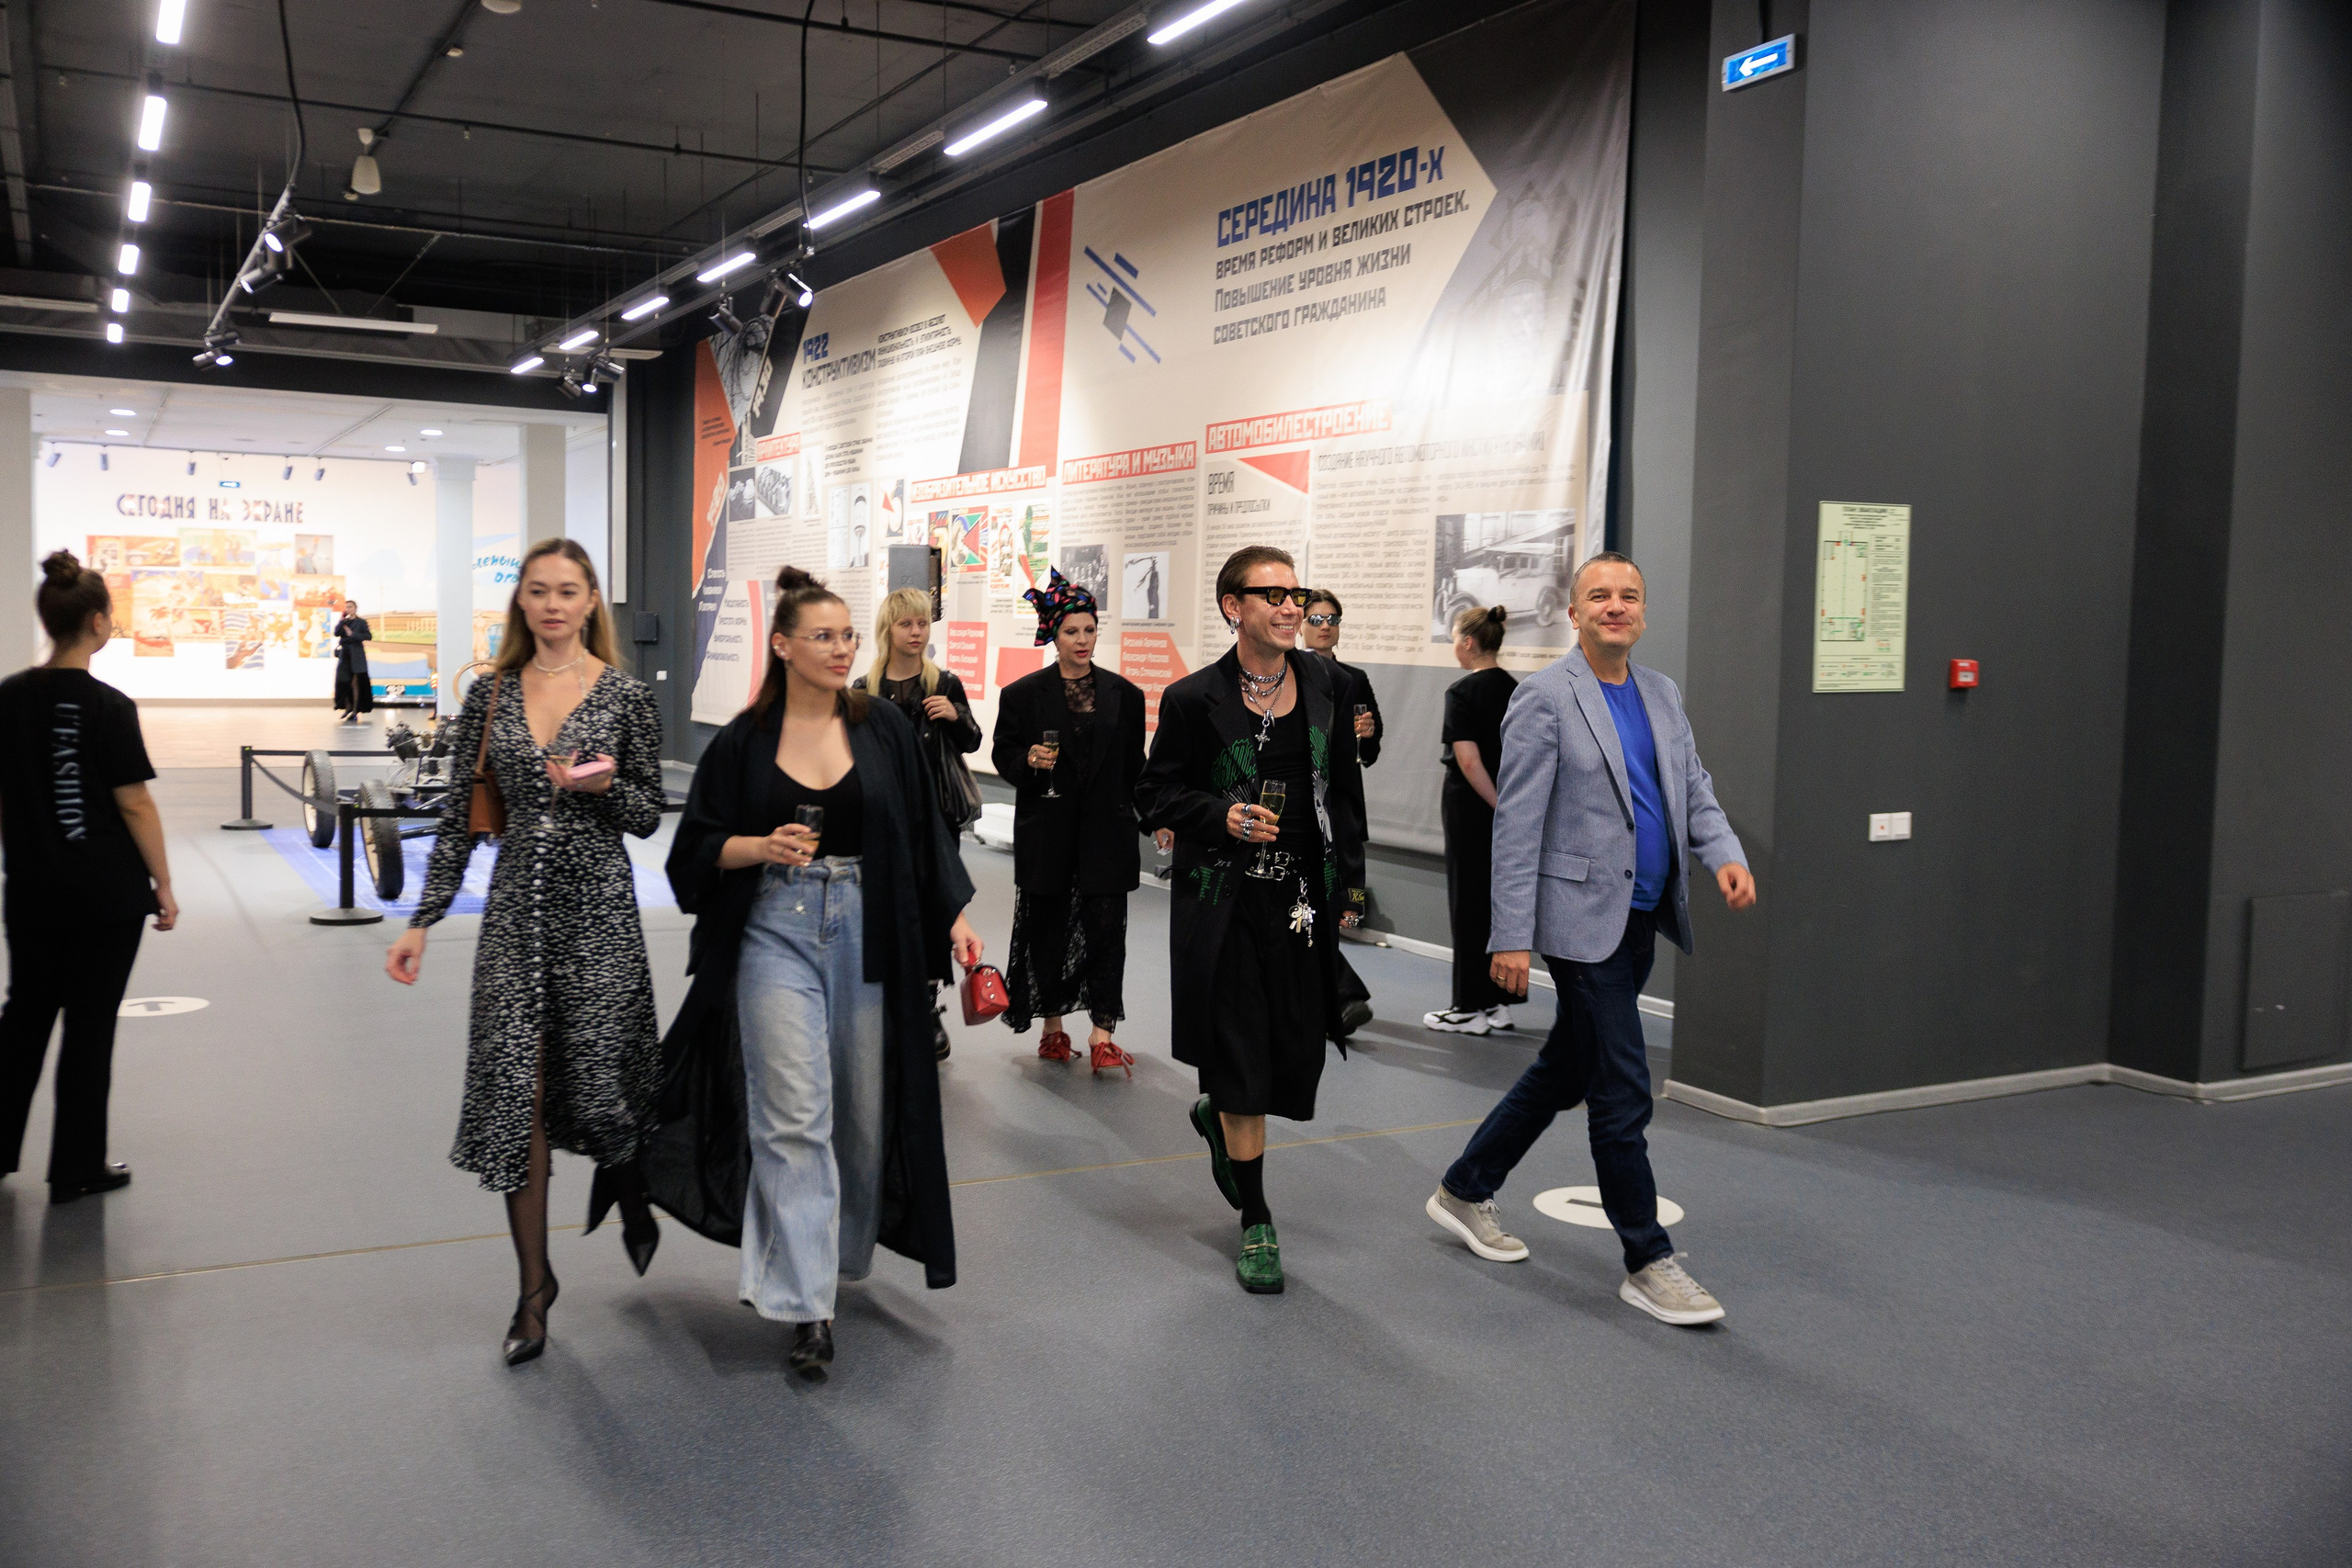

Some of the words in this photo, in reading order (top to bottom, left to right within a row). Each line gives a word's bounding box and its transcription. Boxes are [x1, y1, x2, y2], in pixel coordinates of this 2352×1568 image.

[1217, 174, 1336, 248] СЕРЕДИНА
[1216, 251, 1256, 280] ВРЕМЯ
[1260, 234, 1314, 267] РЕФОРМ
[1318, 233, 1328, 251] И
[1332, 209, 1399, 247] ВЕЛИКИХ
[1298, 258, 1352, 291] УРОВНЯ
[1357, 243, 1411, 276] ЖИЗНИ
[1214, 310, 1290, 344] СОВЕТСКОГО
[1295, 287, 1386, 326] ГРАЖДАНИНА
[802, 332, 829, 365] 1922
[1208, 402, 1390, 452] АВТОМОБИЛЕСТРОЕНИЕ
[991, 466, 1046, 491] ИСКУССТВО
[1064, 454, 1130, 482] ЛИТЕРАТУРА
[1132, 451, 1141, 474] И
[1143, 444, 1194, 472] МУЗЫКА
[1208, 471, 1235, 495] ВРЕМЯ
[117, 493, 195, 519] СЕГОДНЯ
[209, 498, 230, 520] НА
